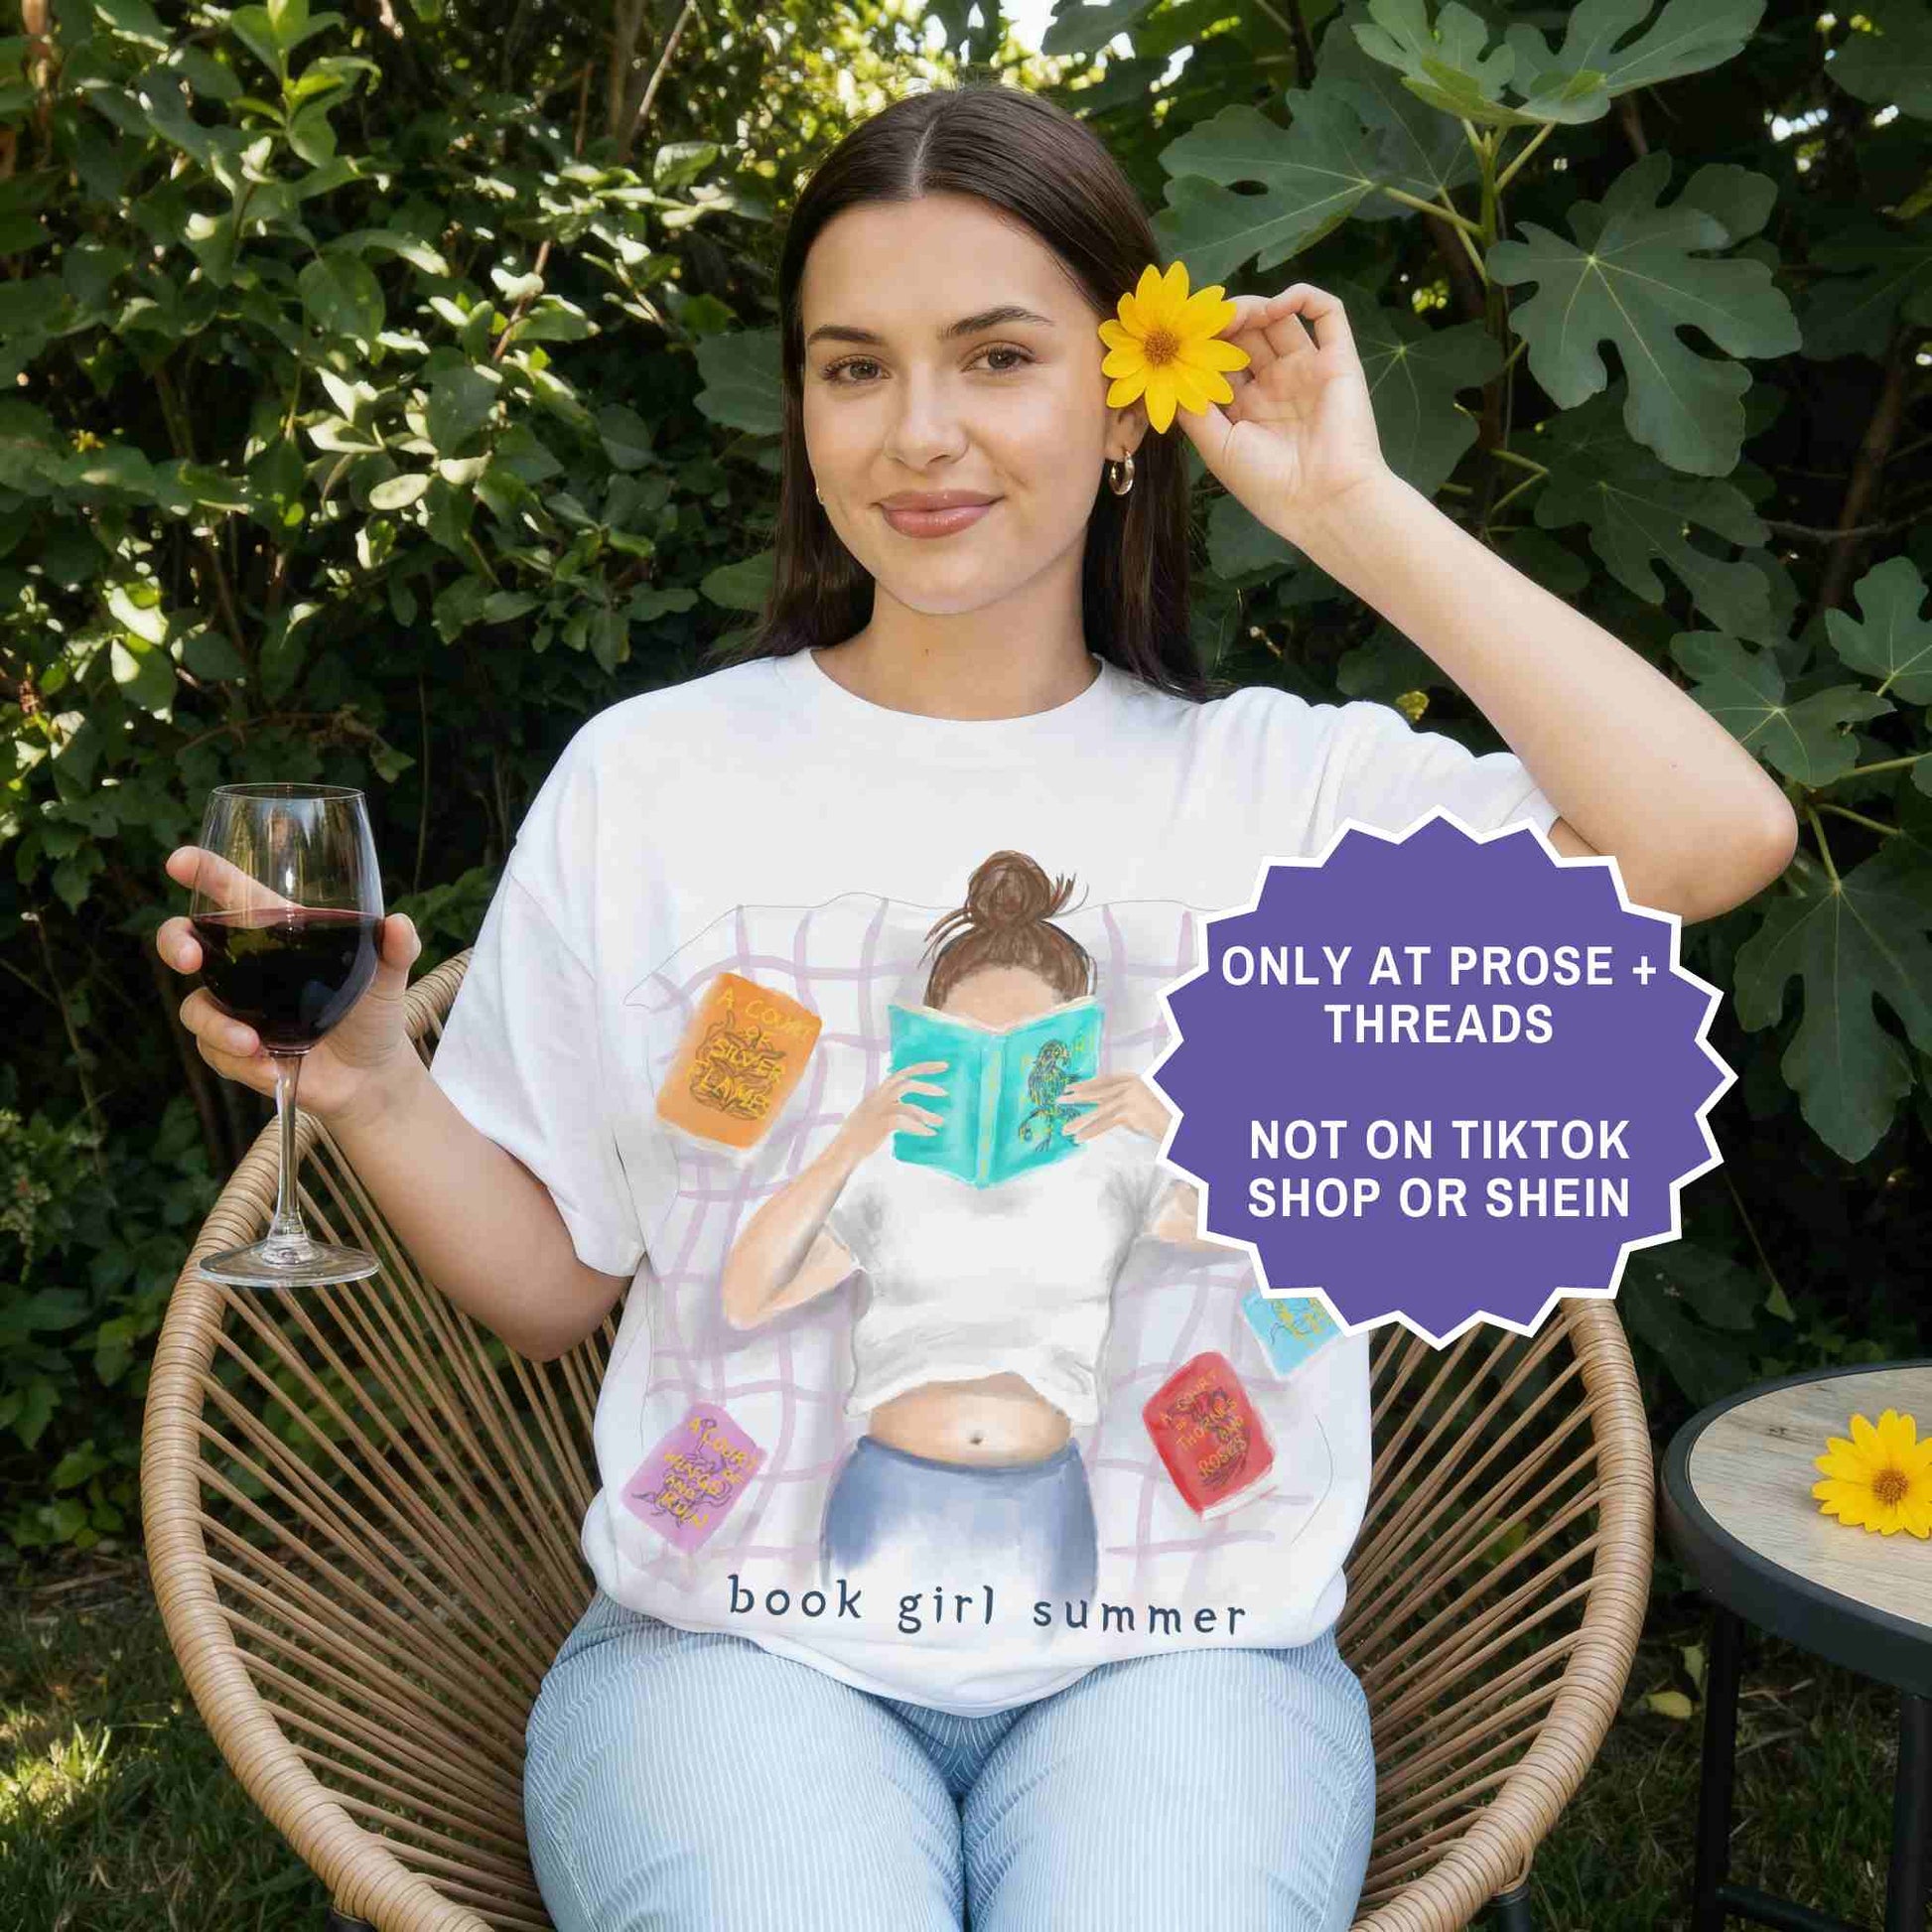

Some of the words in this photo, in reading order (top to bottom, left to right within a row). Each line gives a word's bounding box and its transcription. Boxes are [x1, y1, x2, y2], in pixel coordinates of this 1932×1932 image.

[716, 986, 736, 1009] A
[710, 1037, 786, 1084] SILVER
[727, 1574, 862, 1618] book
[897, 1585, 994, 1634] girl
[1033, 1599, 1247, 1635] summer
